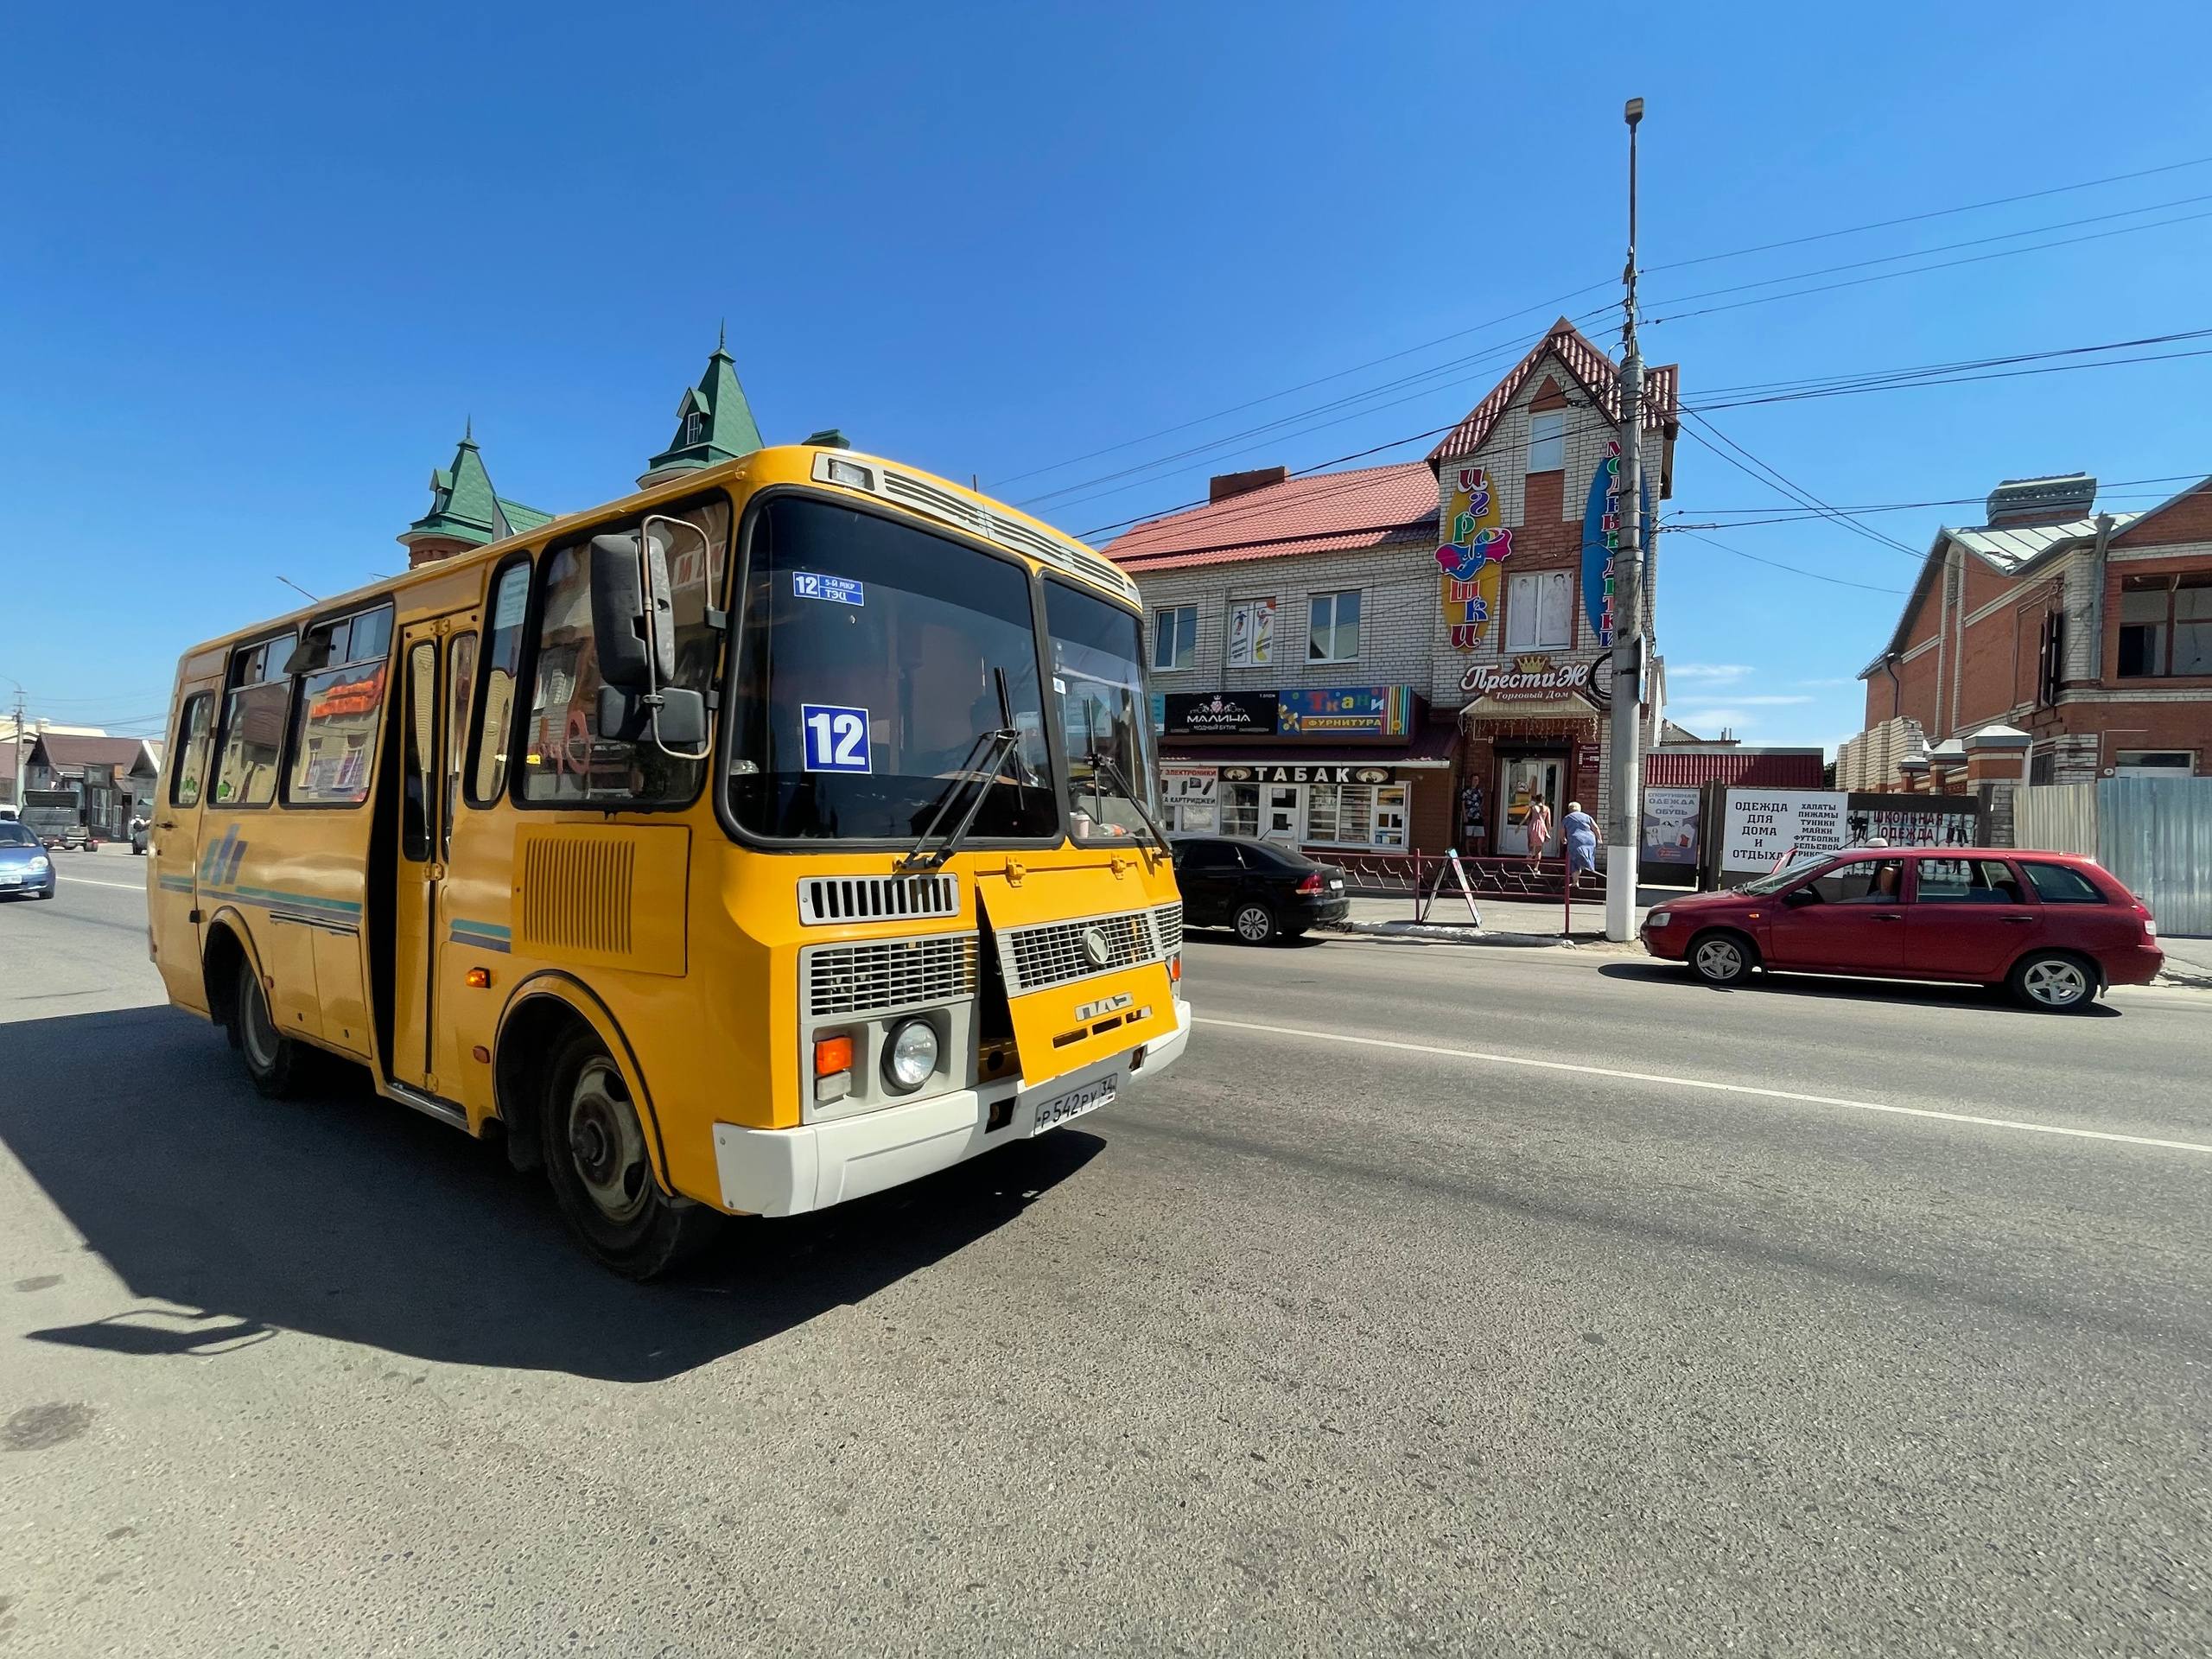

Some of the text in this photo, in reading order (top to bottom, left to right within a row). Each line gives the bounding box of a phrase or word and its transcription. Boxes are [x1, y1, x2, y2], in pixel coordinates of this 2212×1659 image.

[795, 575, 818, 595] 12
[839, 582, 855, 590] МКР
[824, 589, 848, 601] ТЭЦ
[1496, 690, 1569, 701] Торговый Дом
[1186, 714, 1251, 723] МАЛИНА
[807, 713, 866, 766] 12
[1255, 766, 1350, 783] ТАБАК
[1735, 801, 1789, 812] ОДЕЖДА
[1746, 814, 1773, 824] ДЛЯ
[1873, 810, 1943, 825] ШКОЛЬНАЯ
[1741, 826, 1777, 836] ДОМА
[1880, 826, 1934, 841] ОДЕЖДА
[1754, 838, 1764, 847] И
[1794, 842, 1840, 851] БЕЛЬЕВОЙ
[1076, 993, 1133, 1021] ПАЗ
[1101, 1077, 1114, 1097] 34
